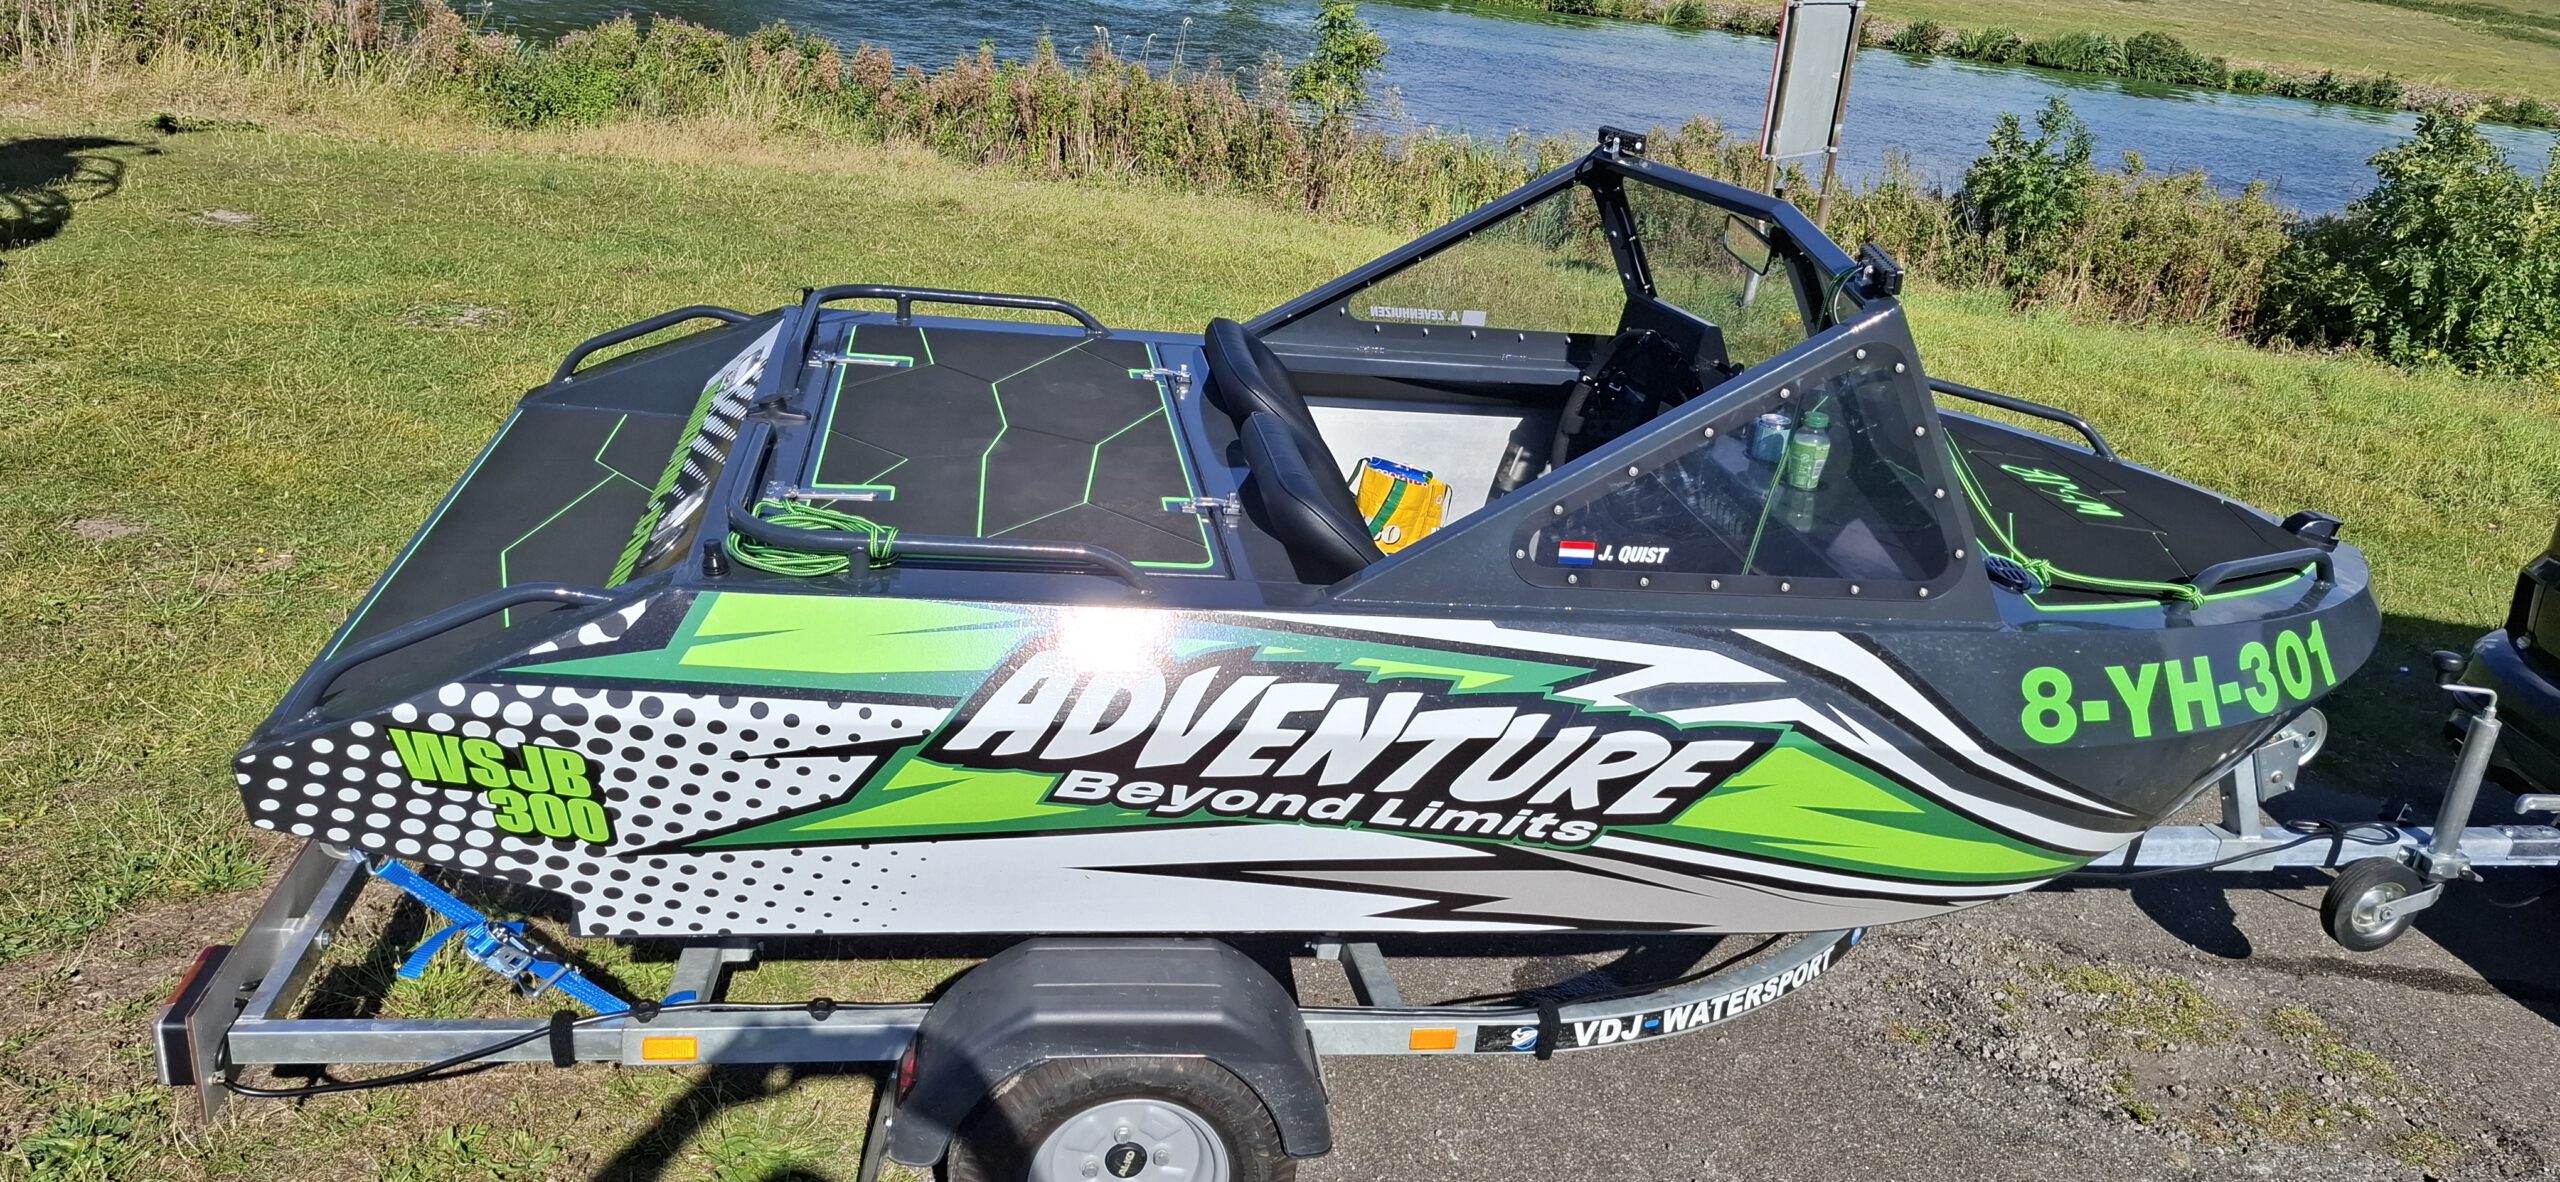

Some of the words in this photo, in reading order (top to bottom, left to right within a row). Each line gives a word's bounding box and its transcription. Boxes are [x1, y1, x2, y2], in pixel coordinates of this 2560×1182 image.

[1598, 544, 1614, 561] J.
[1618, 545, 1669, 564] QUIST
[2021, 620, 2338, 745] 8-YH-301
[388, 728, 592, 798] WSJB
[943, 650, 1755, 816] ADVENTURE
[488, 788, 610, 843] 300
[1053, 769, 1365, 822] Beyond
[1368, 798, 1599, 844] Limits
[1574, 945, 1835, 1047] VDJ-WATERSPORT
